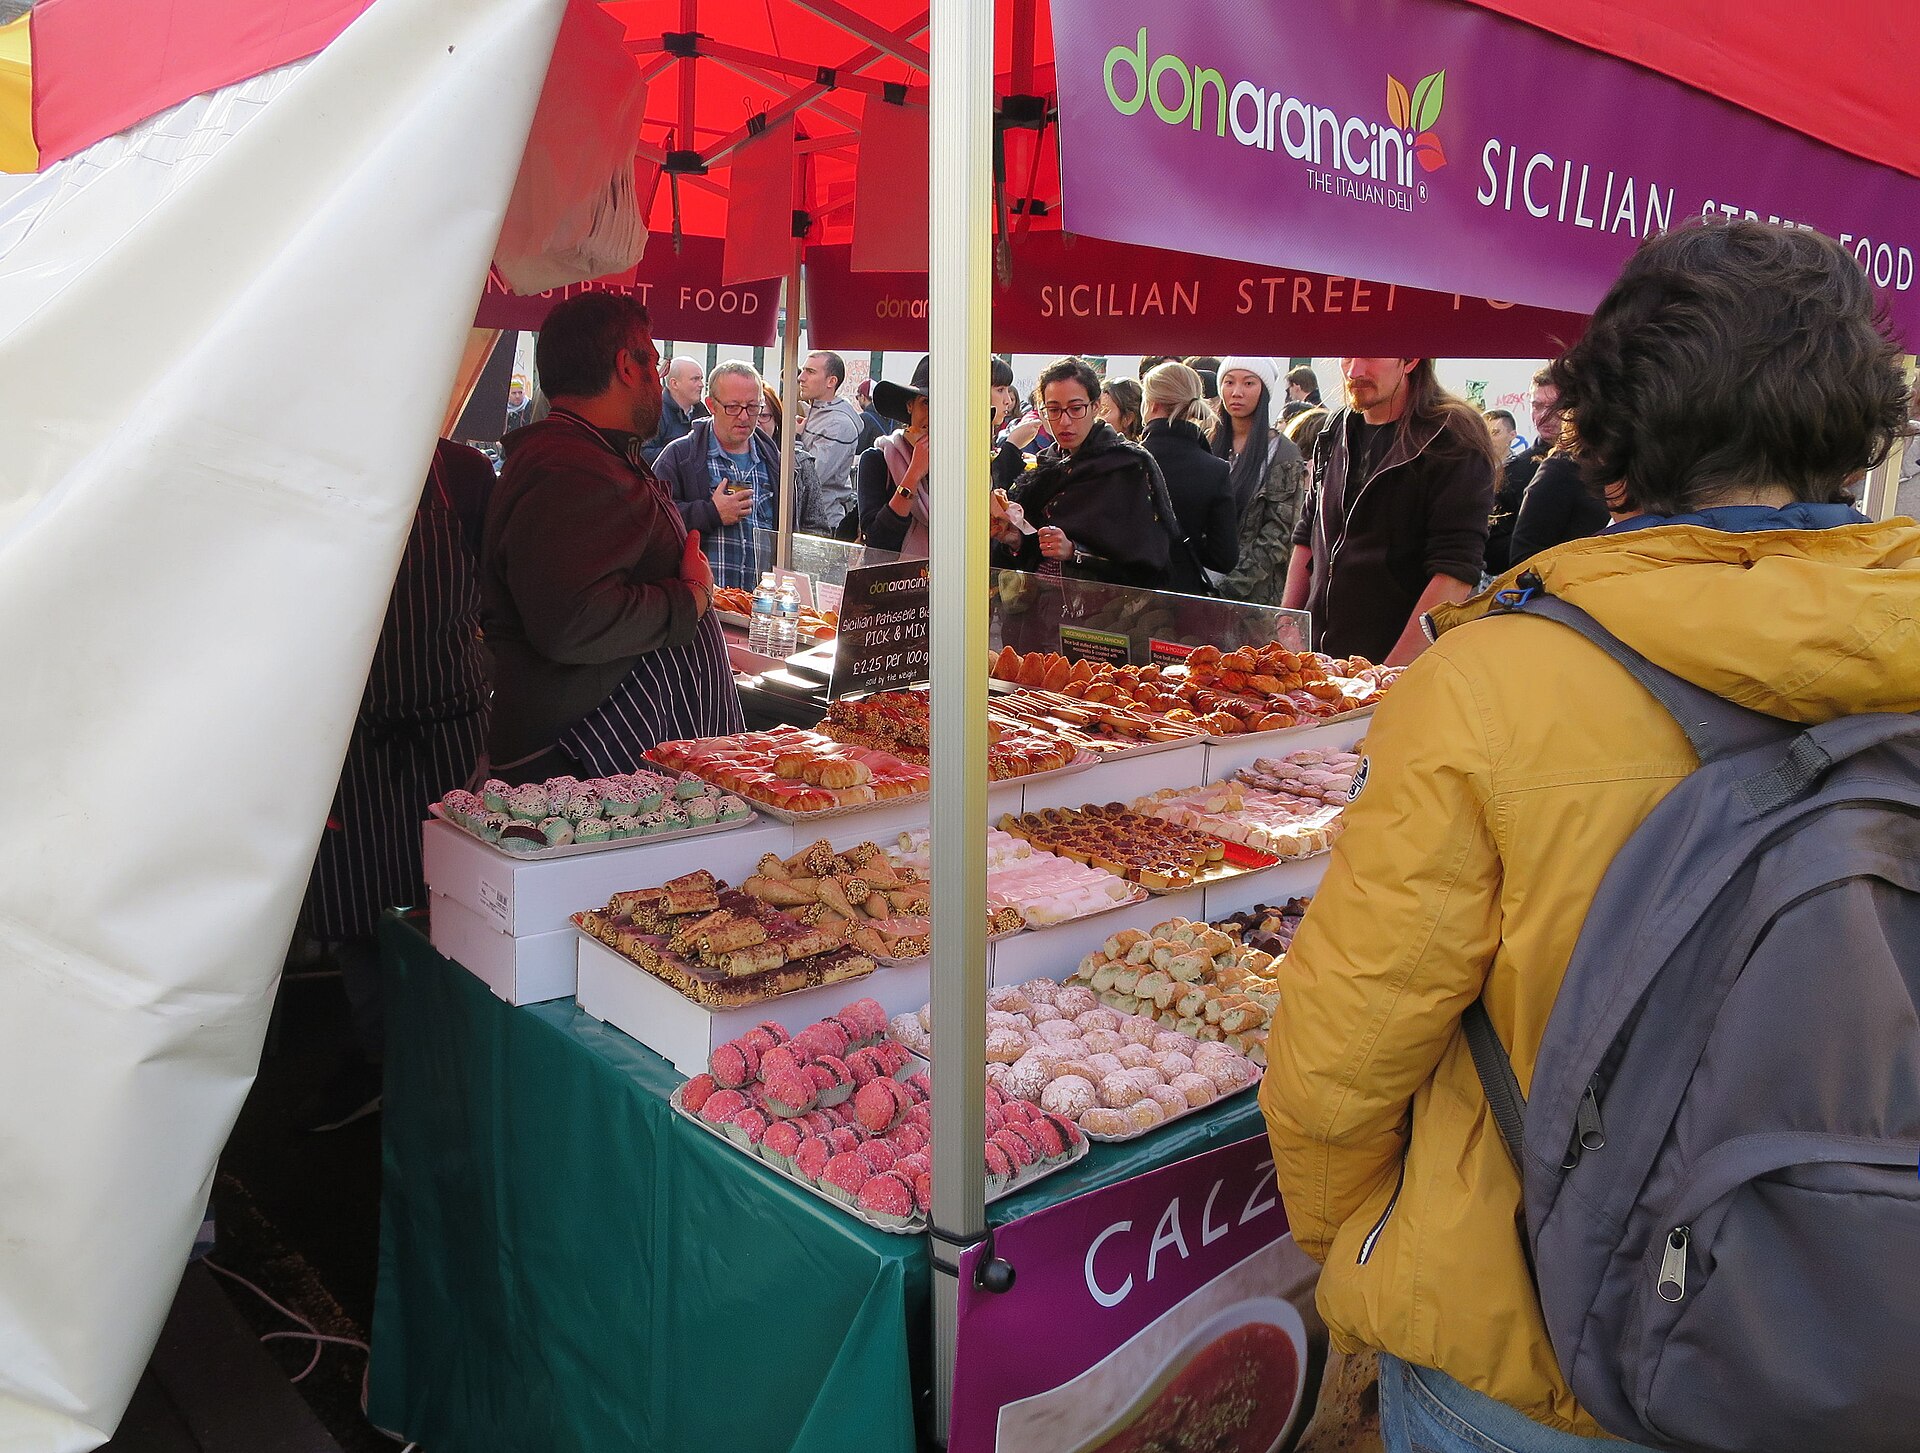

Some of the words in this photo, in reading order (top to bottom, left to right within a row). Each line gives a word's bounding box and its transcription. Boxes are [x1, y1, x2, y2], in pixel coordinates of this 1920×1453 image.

[1103, 26, 1415, 189] donarancini
[1306, 168, 1333, 194] THE
[1336, 176, 1384, 206] ITALIAN
[1387, 189, 1413, 212] DELI
[1477, 138, 1674, 240] SICILIAN
[679, 286, 760, 316] FOOD
[1041, 281, 1200, 317] SICILIAN
[841, 615, 873, 632] Sicilian
[865, 627, 891, 647] PICK
[894, 625, 901, 641] &
[904, 622, 927, 640] MIX
[852, 655, 883, 676] £2.25
[886, 652, 903, 672] per
[887, 674, 897, 682] the
[898, 668, 918, 681] weight
